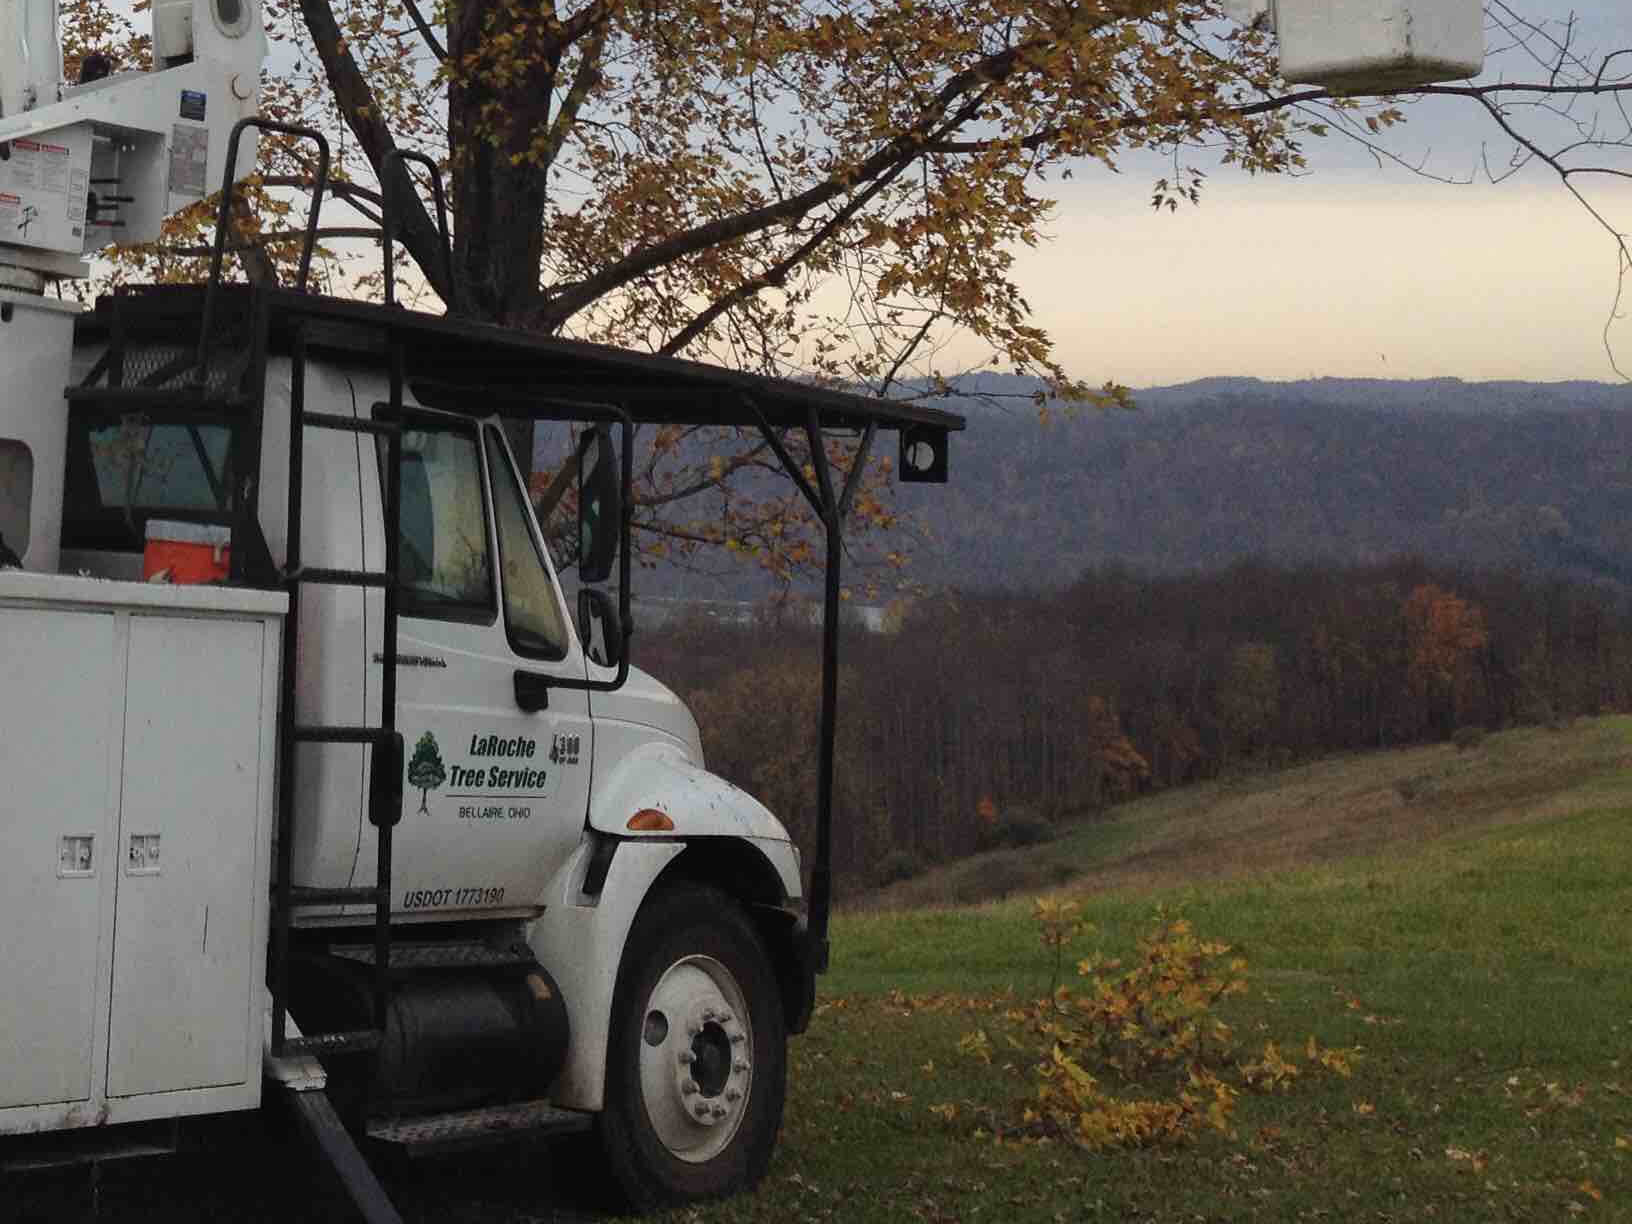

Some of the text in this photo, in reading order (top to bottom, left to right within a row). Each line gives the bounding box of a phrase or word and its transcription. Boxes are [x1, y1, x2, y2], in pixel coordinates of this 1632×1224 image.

[470, 734, 535, 759] LaRoche
[449, 765, 546, 789] Tree Service
[508, 807, 530, 818] OHIO
[403, 888, 453, 908] USDOT
